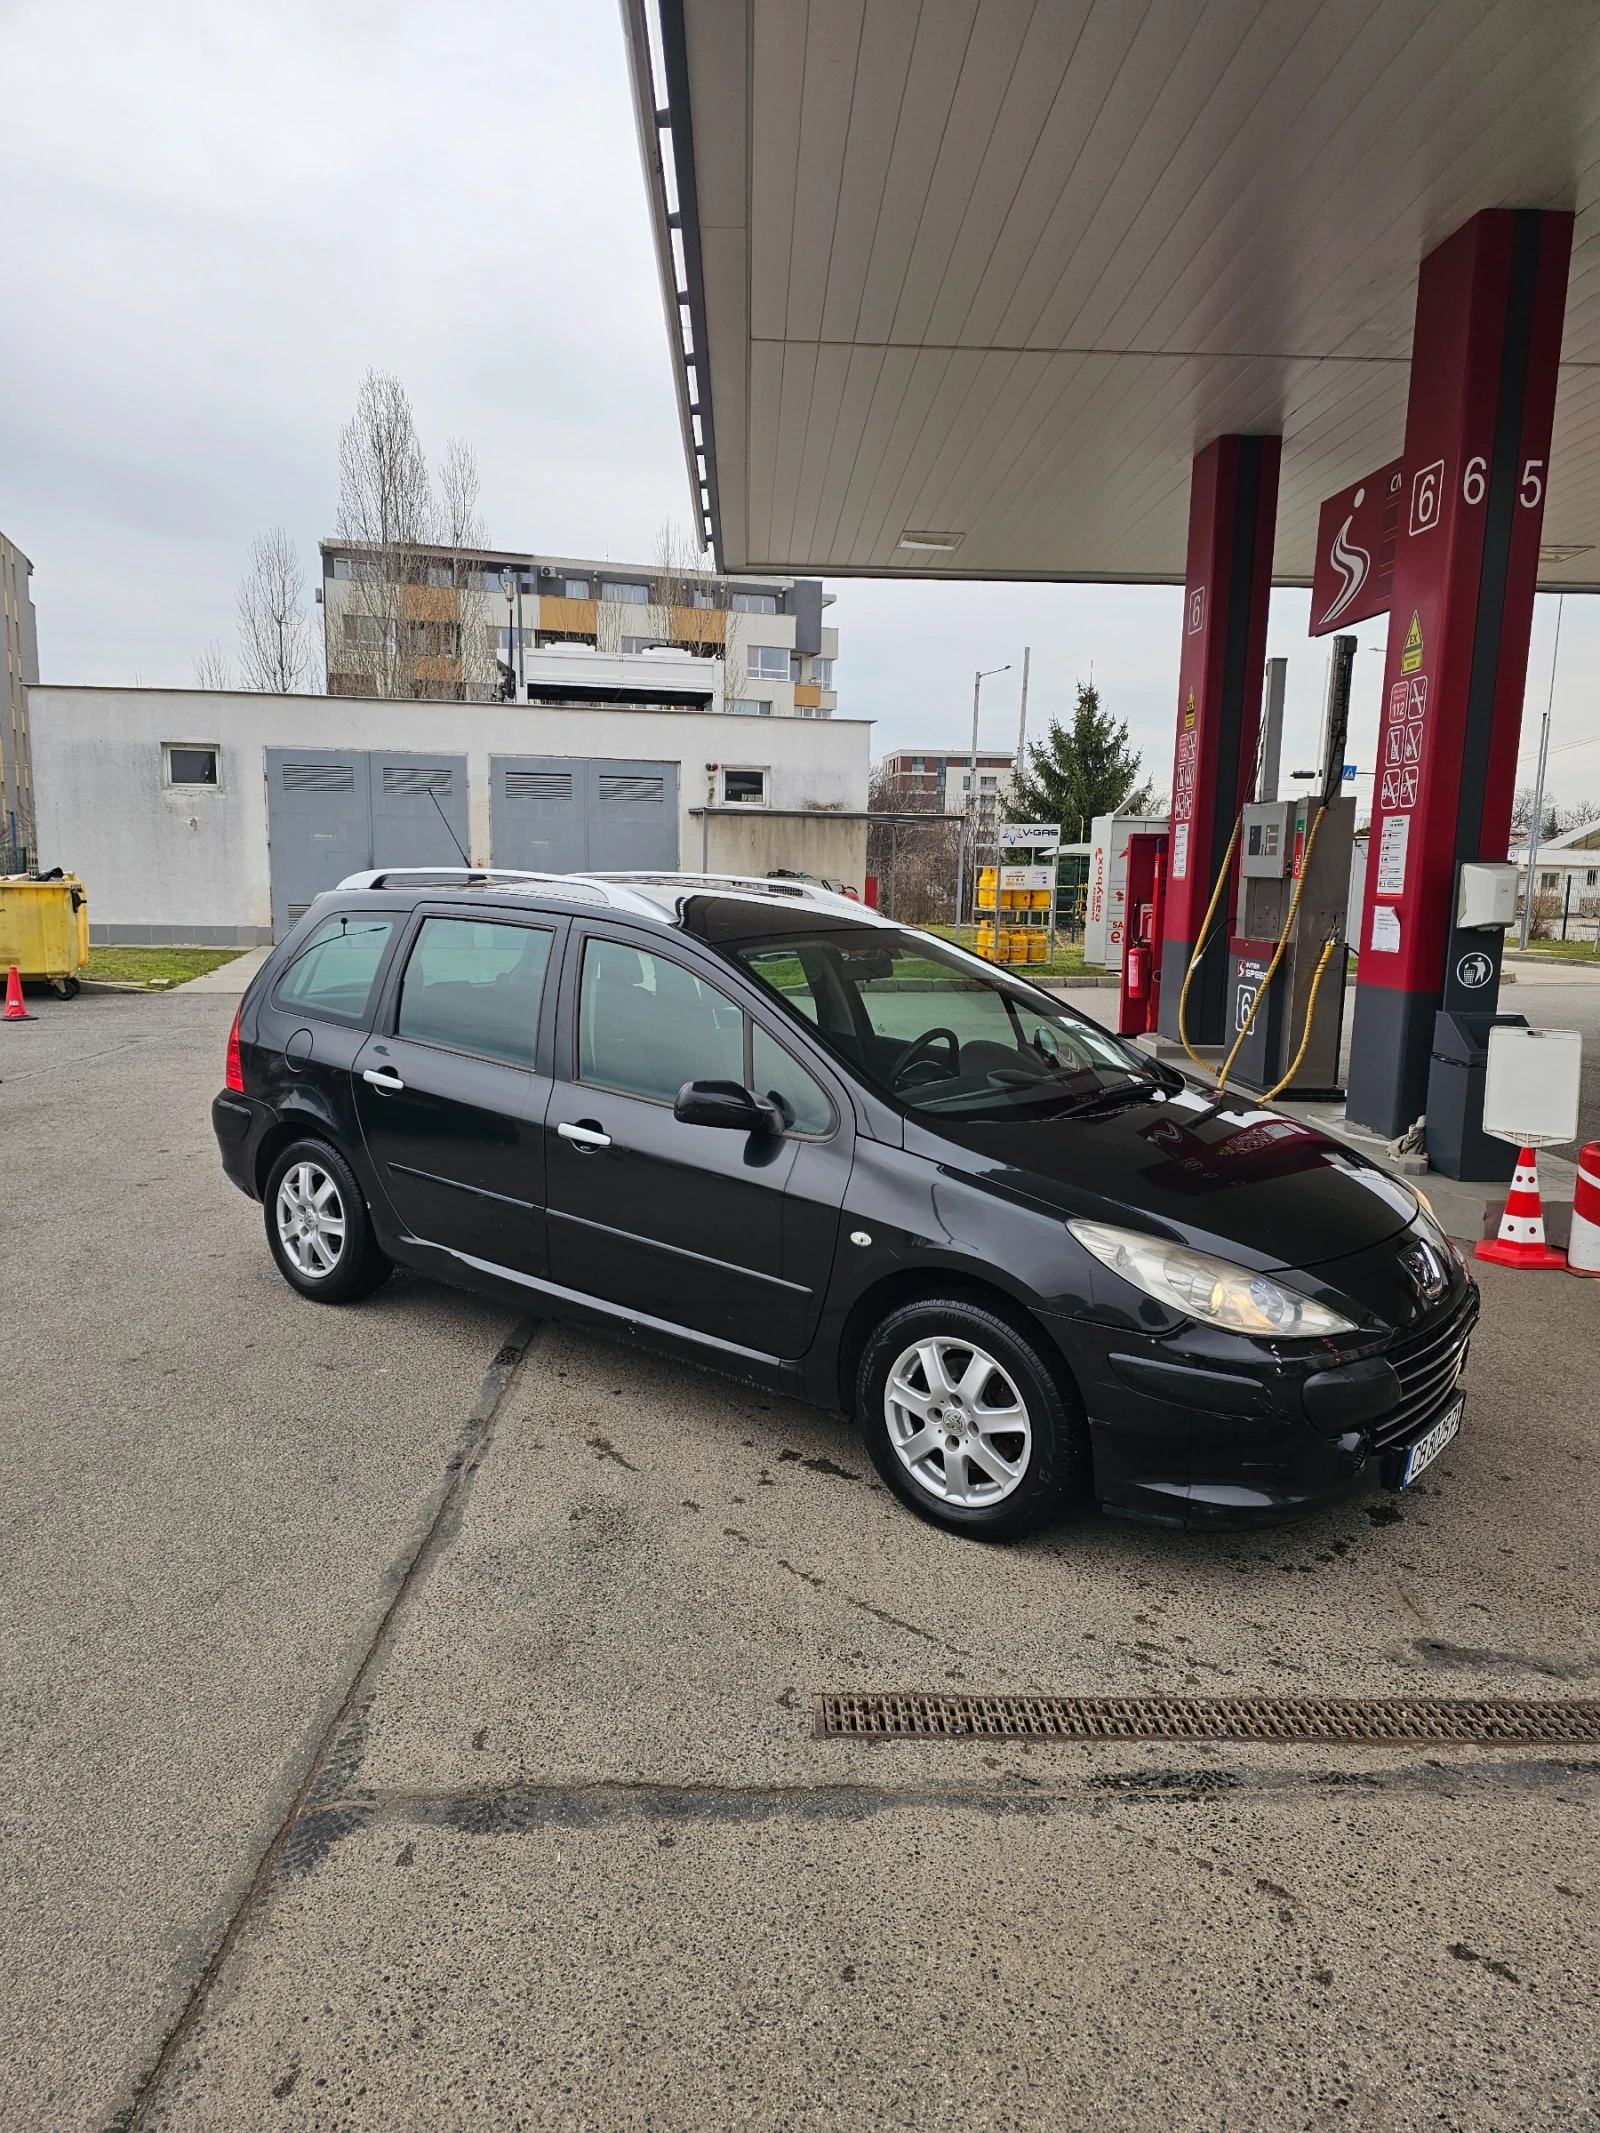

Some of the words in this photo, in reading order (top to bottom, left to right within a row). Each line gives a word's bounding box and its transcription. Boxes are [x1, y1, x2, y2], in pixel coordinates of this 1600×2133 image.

[1463, 456, 1487, 505] 6
[1520, 460, 1543, 508] 5
[1418, 474, 1435, 522] 6
[1192, 594, 1201, 626] 6
[1410, 632, 1418, 646] EX
[1392, 701, 1405, 716] 112
[1022, 828, 1058, 836] V-GAS
[1094, 857, 1104, 922] easybox
[1241, 992, 1251, 1026] 6
